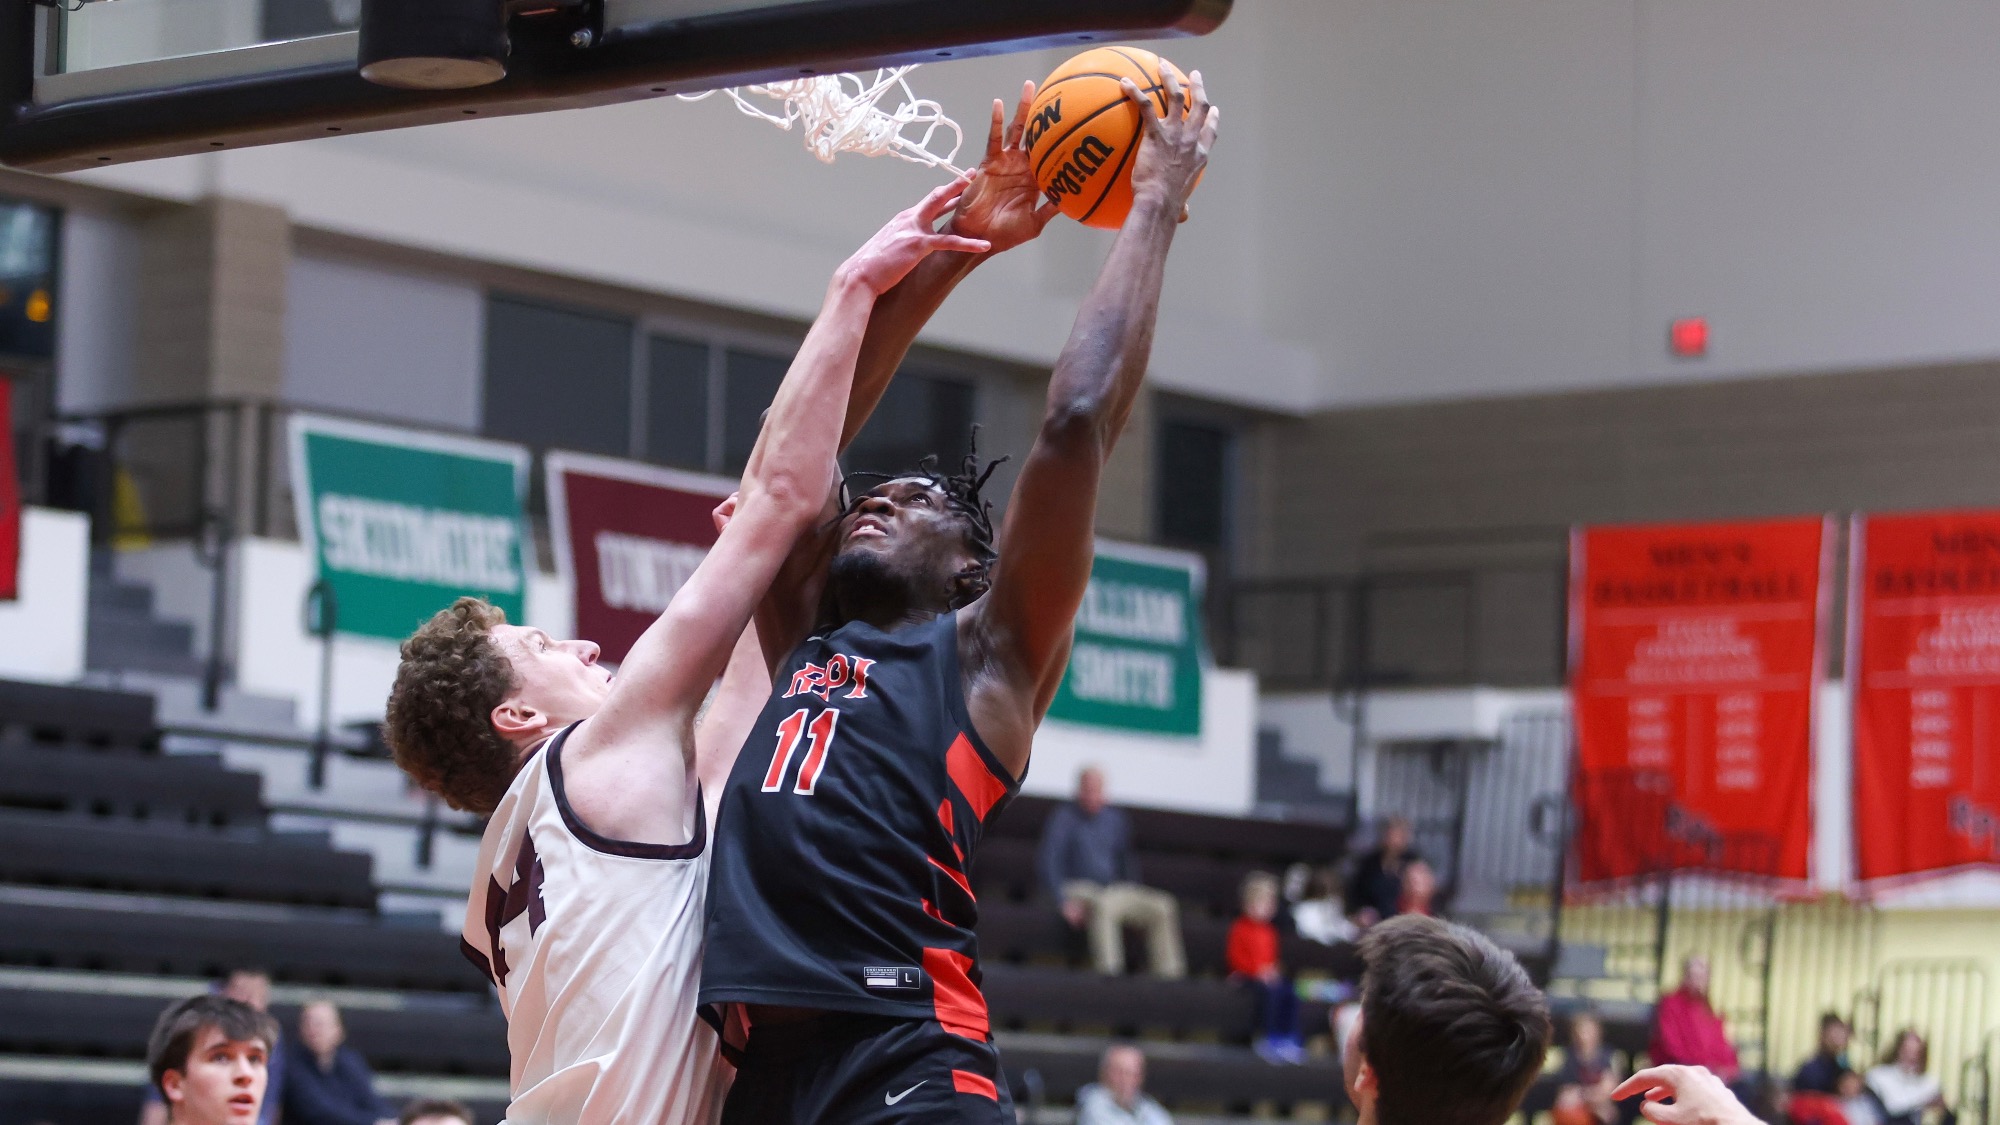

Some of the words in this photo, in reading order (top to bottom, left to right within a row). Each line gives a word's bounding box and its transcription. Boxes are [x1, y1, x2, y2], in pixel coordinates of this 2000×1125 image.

[782, 653, 877, 702] RPI
[1070, 644, 1174, 711] SMITH
[761, 708, 840, 796] 11
[905, 972, 912, 983] L
